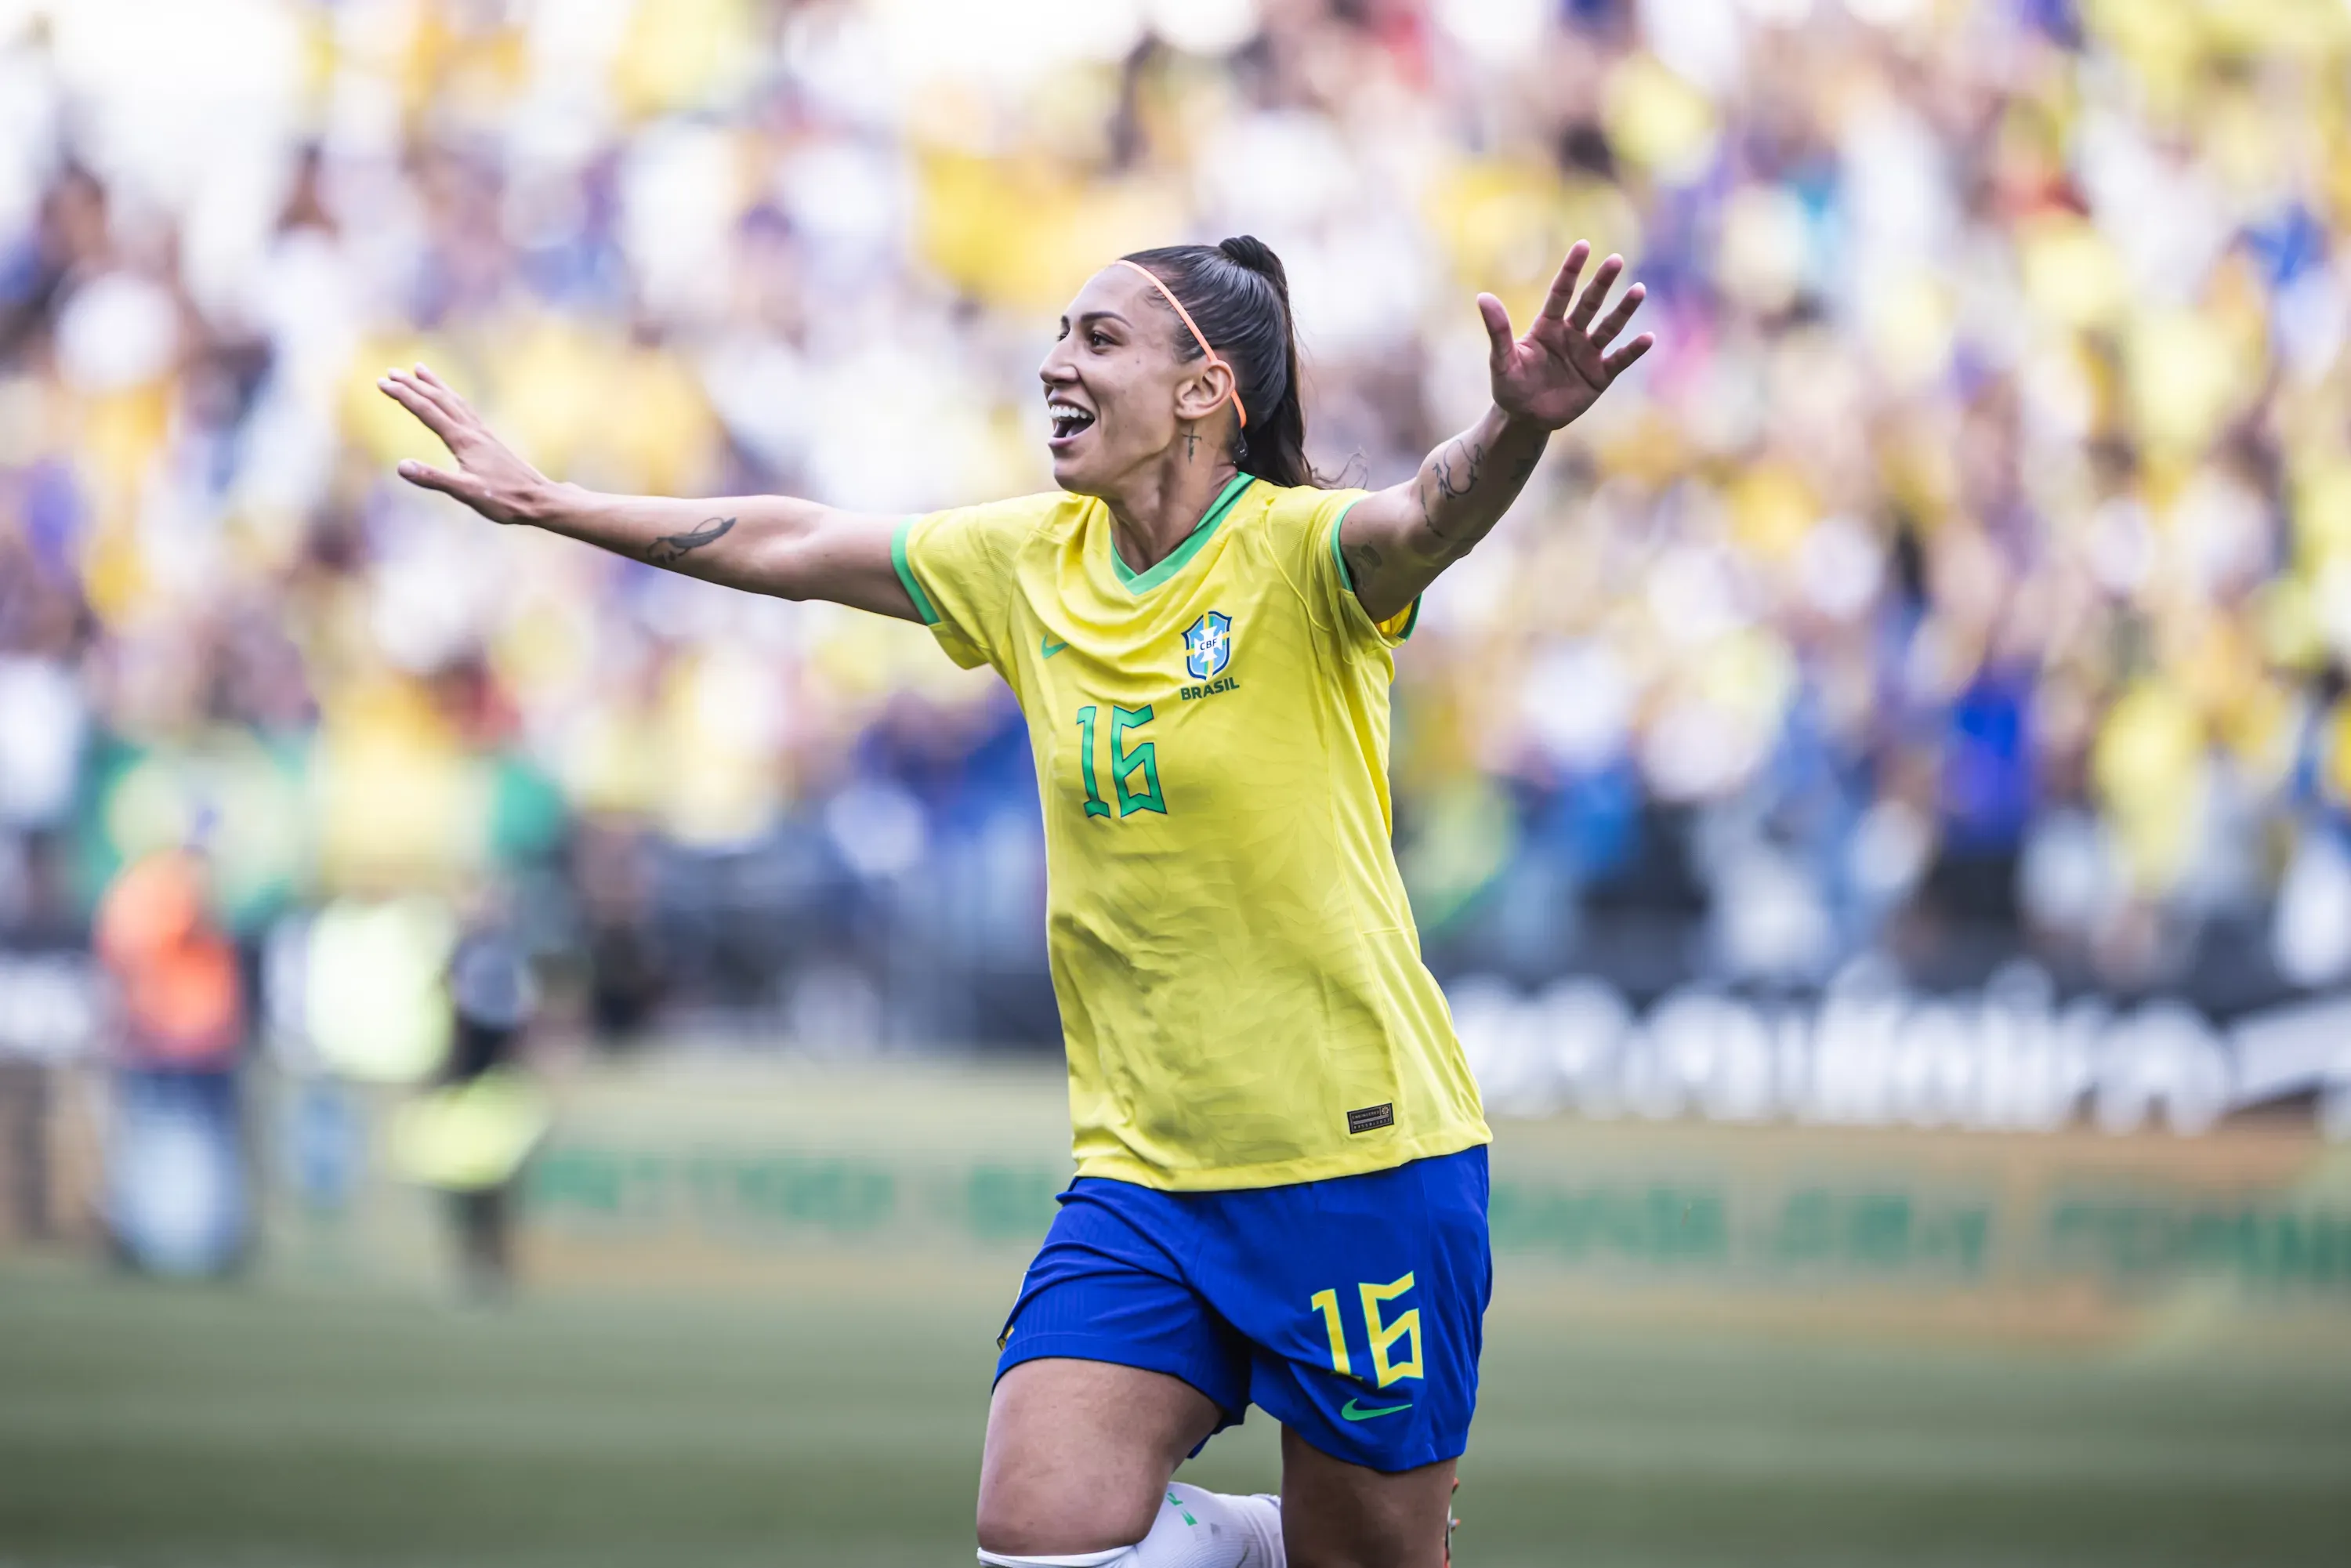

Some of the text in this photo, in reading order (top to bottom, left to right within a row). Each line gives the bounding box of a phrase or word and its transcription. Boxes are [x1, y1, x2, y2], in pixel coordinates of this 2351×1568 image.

[1200, 638, 1218, 650] CBF
[1180, 677, 1240, 701] BRASIL
[1076, 704, 1168, 818] 16
[1310, 1270, 1424, 1389] 16
